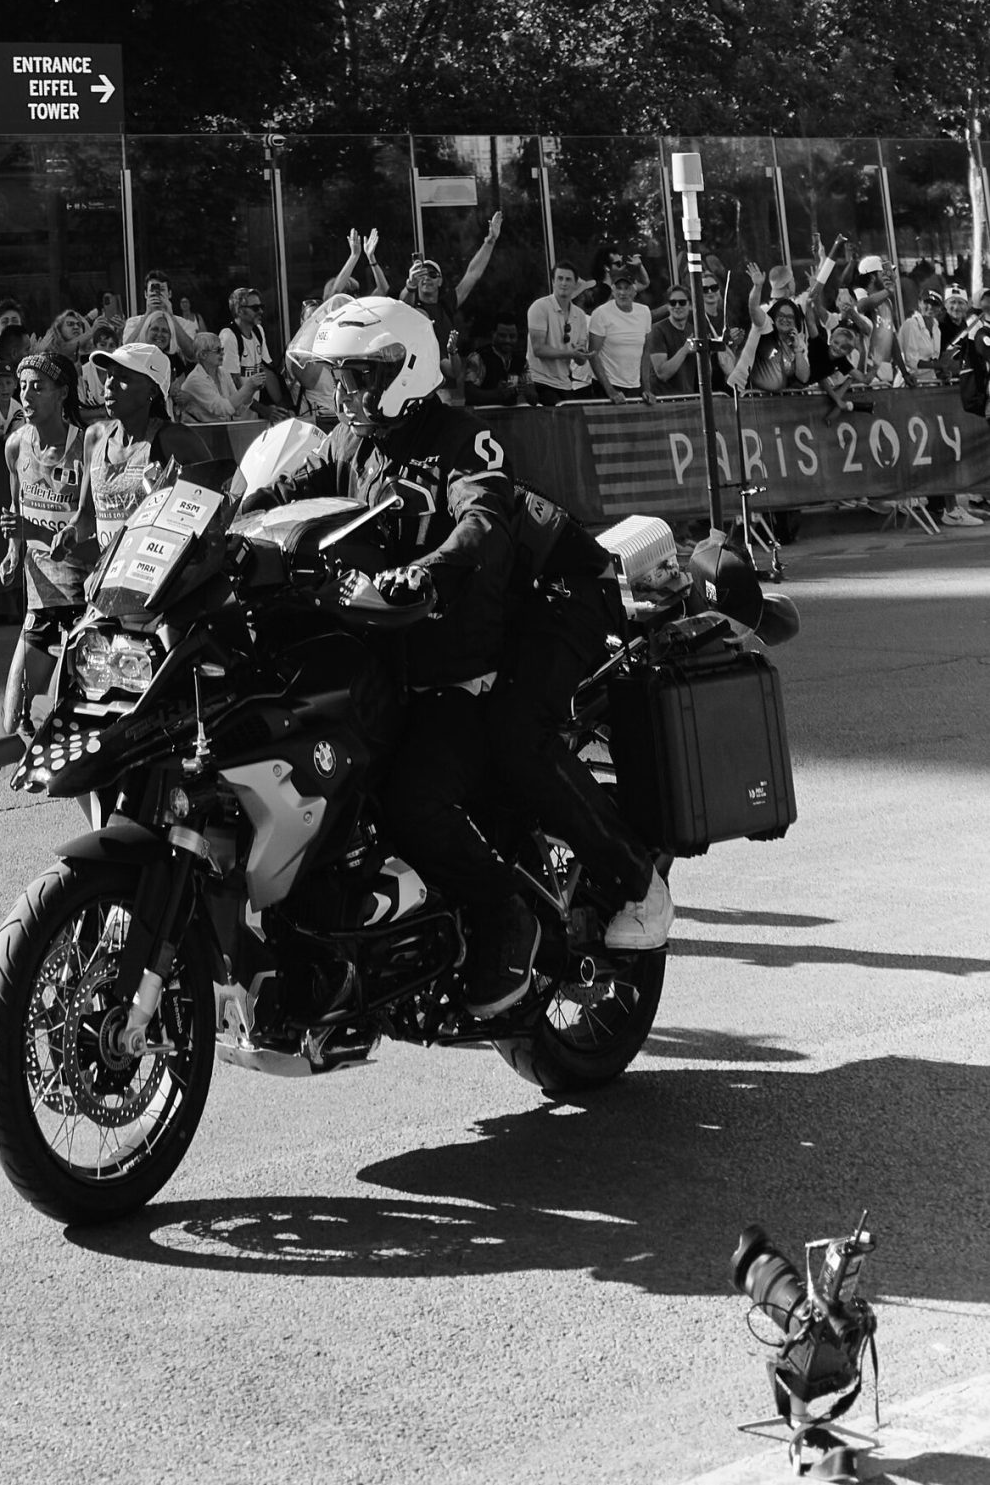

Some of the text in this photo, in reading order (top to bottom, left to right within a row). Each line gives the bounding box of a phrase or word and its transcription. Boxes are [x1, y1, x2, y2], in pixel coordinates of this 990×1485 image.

[12, 56, 92, 74] ENTRANCE
[29, 79, 78, 97] EIFFEL
[27, 102, 80, 120] TOWER
[178, 500, 201, 514] RSM
[145, 542, 165, 555] ALL
